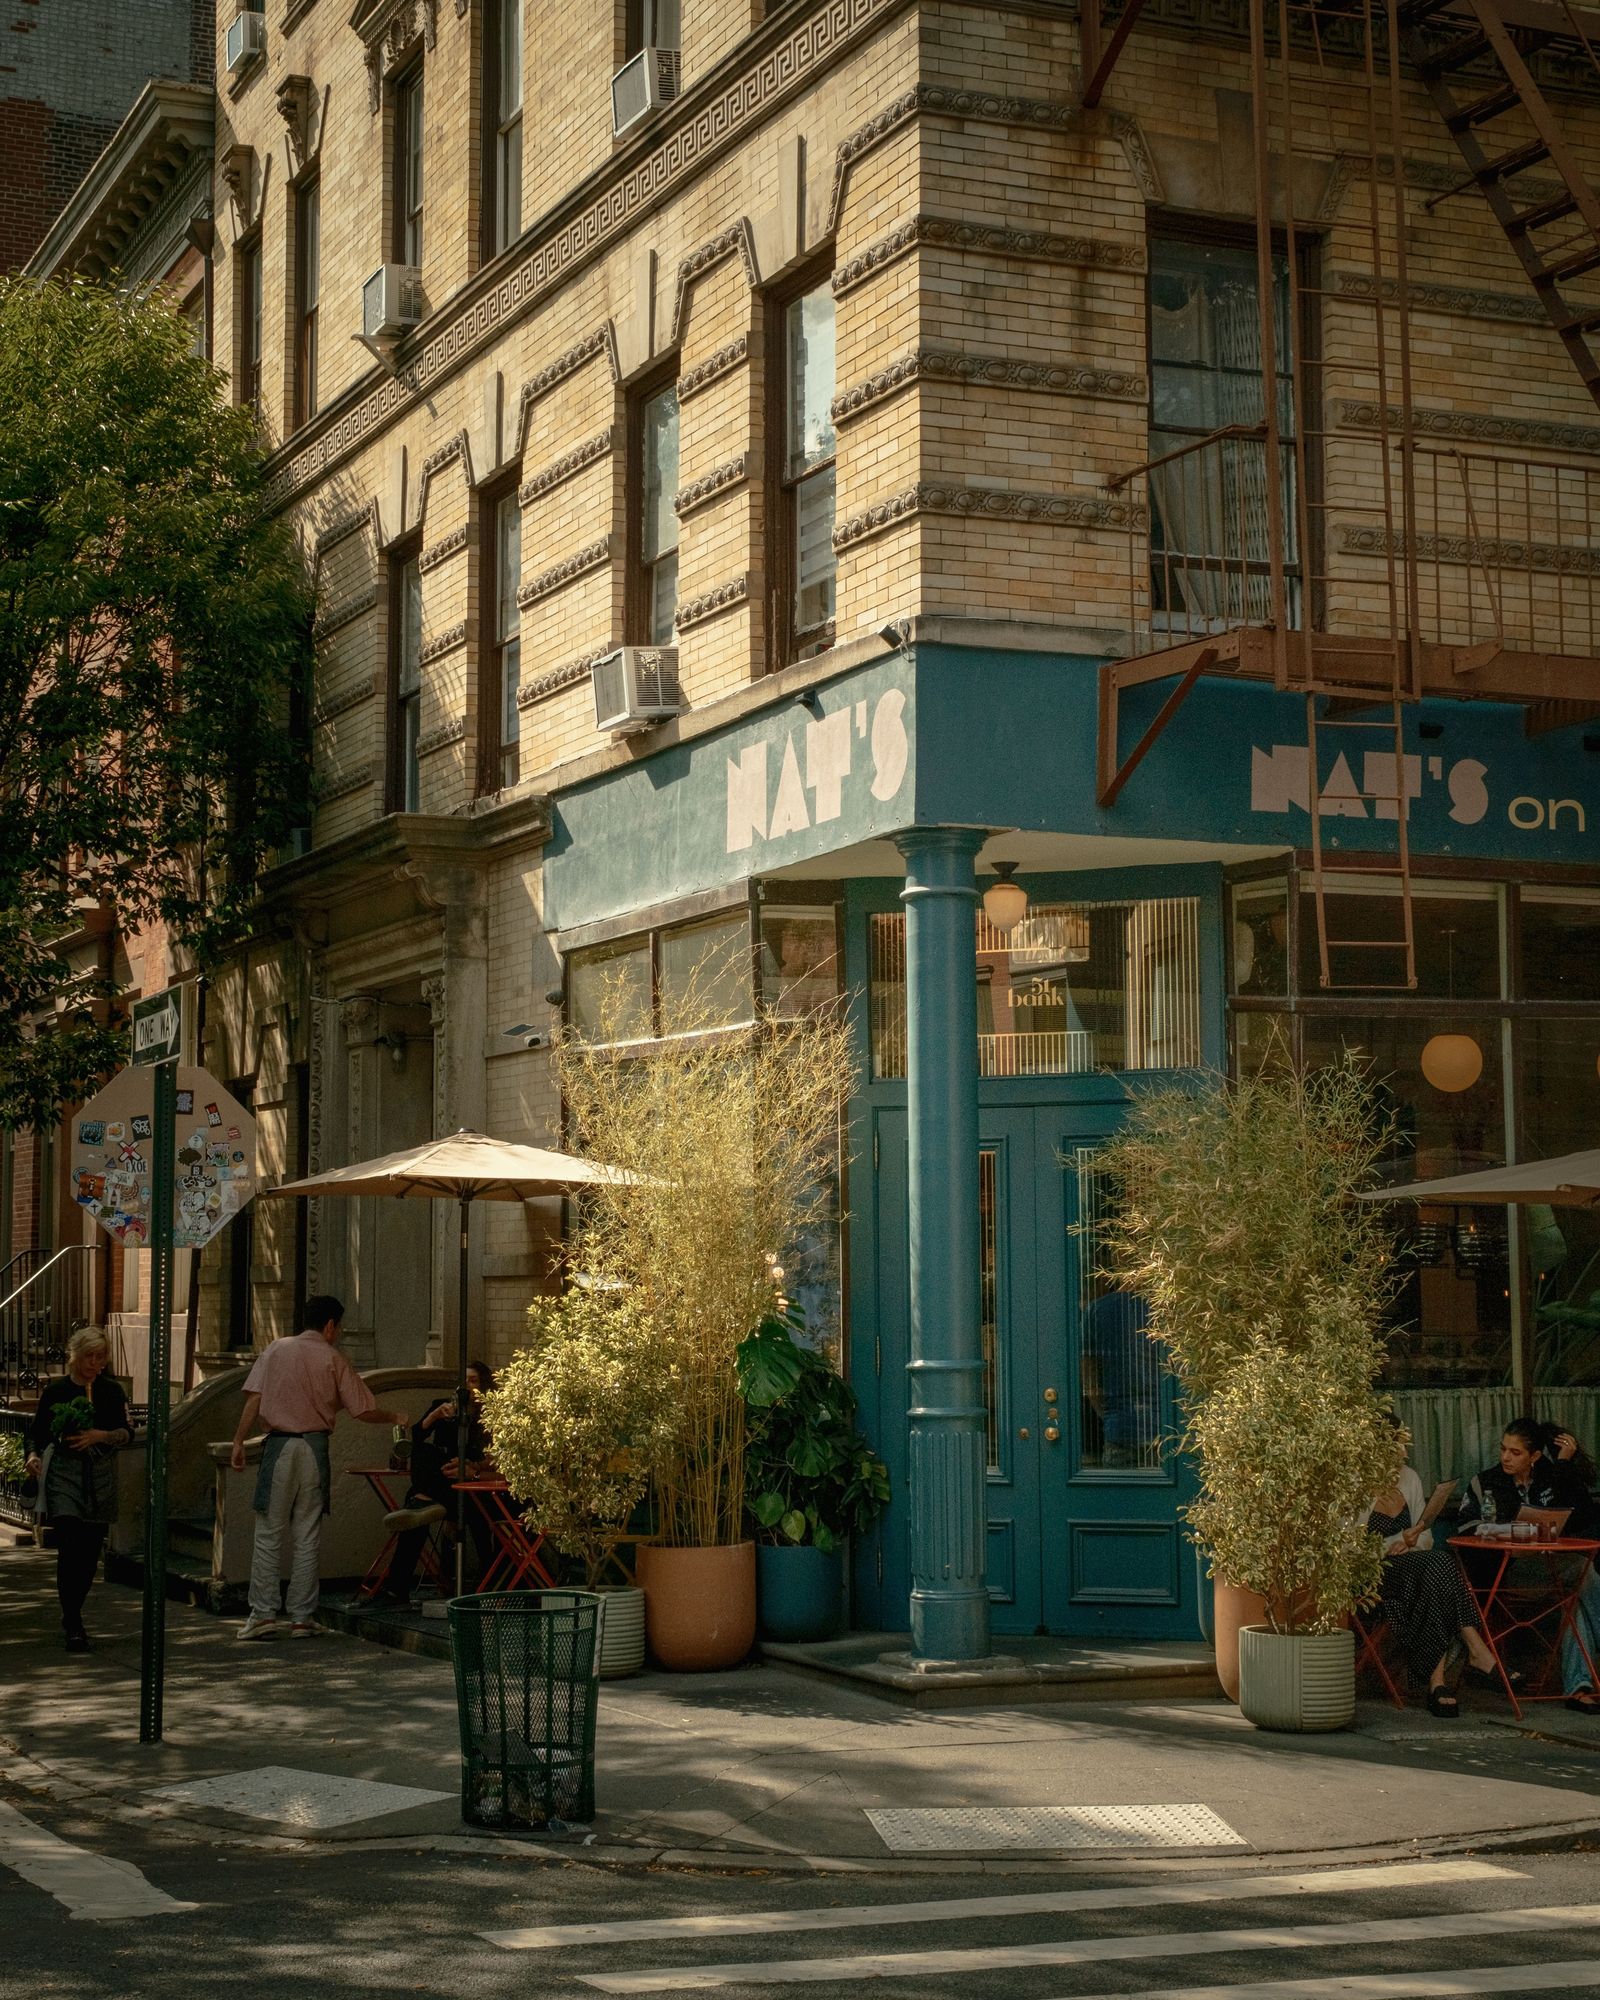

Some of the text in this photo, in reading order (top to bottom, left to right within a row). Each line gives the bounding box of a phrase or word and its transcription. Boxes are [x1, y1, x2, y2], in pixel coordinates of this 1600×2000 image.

[727, 689, 908, 853] NAT'S
[1251, 744, 1585, 832] NAT'S on
[1008, 986, 1064, 1007] bank
[1032, 977, 1049, 995] 51
[140, 1008, 175, 1047] ONE WAY
